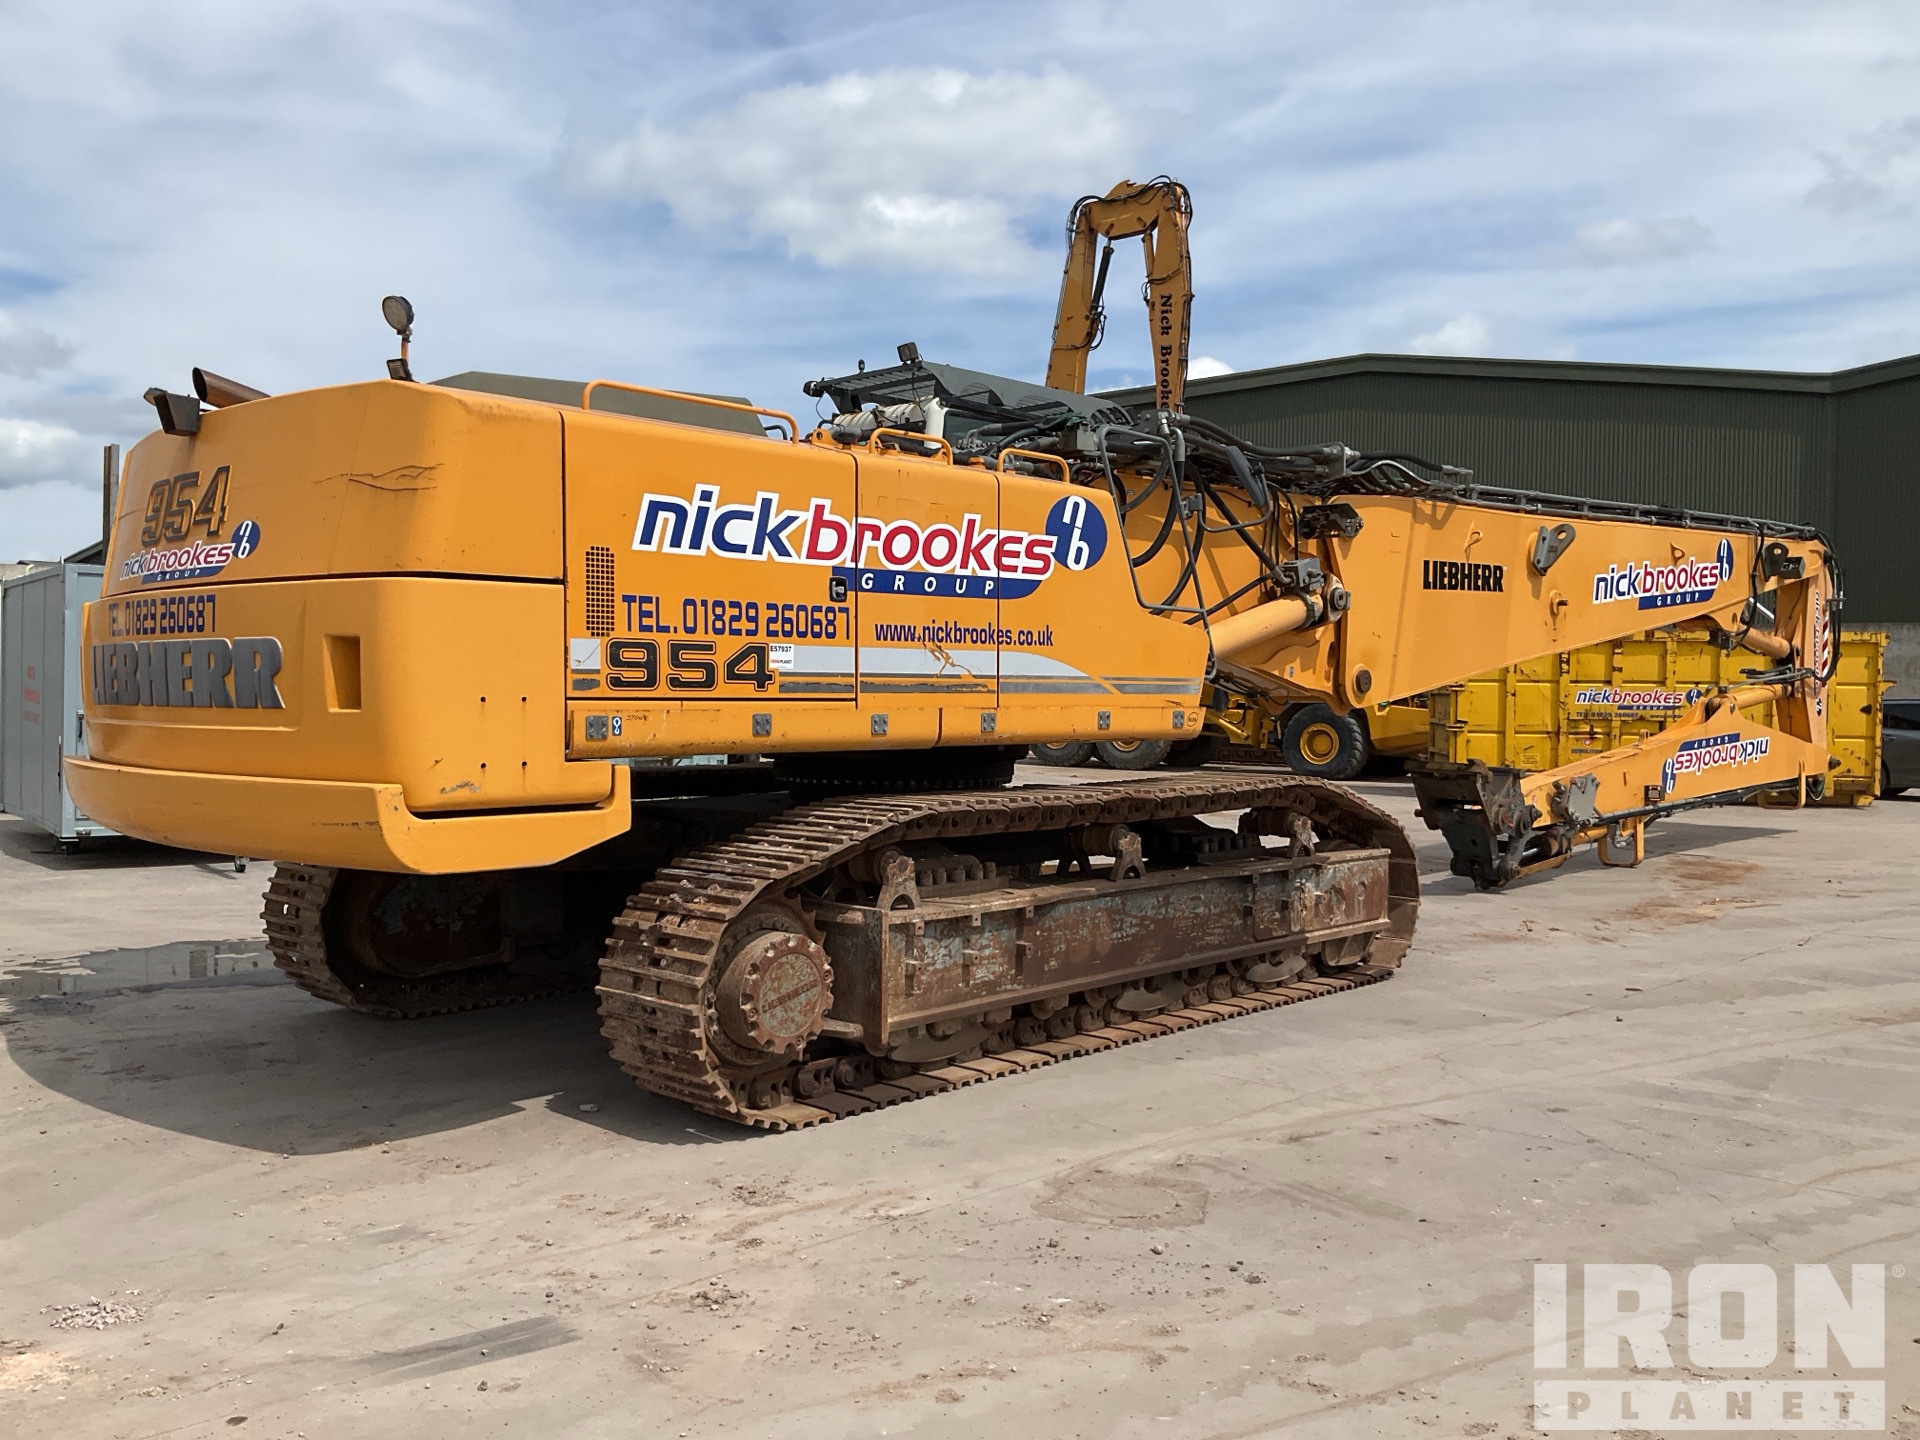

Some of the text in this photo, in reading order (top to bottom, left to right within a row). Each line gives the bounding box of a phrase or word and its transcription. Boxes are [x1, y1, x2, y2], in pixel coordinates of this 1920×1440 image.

[1160, 293, 1173, 409] Nick Brooke
[141, 464, 233, 548] 954
[156, 569, 200, 581] GROUP
[861, 572, 995, 596] GROUP
[1422, 559, 1505, 593] LIEBHERR
[125, 598, 157, 636] 01829
[160, 594, 217, 634] 260687
[622, 593, 851, 640] TEL. 01829 260687
[1656, 592, 1700, 606] GROUP
[874, 619, 1054, 648] www.nickbrookes.co.uk
[92, 636, 286, 710] LIEBHERR
[606, 637, 775, 692] 954
